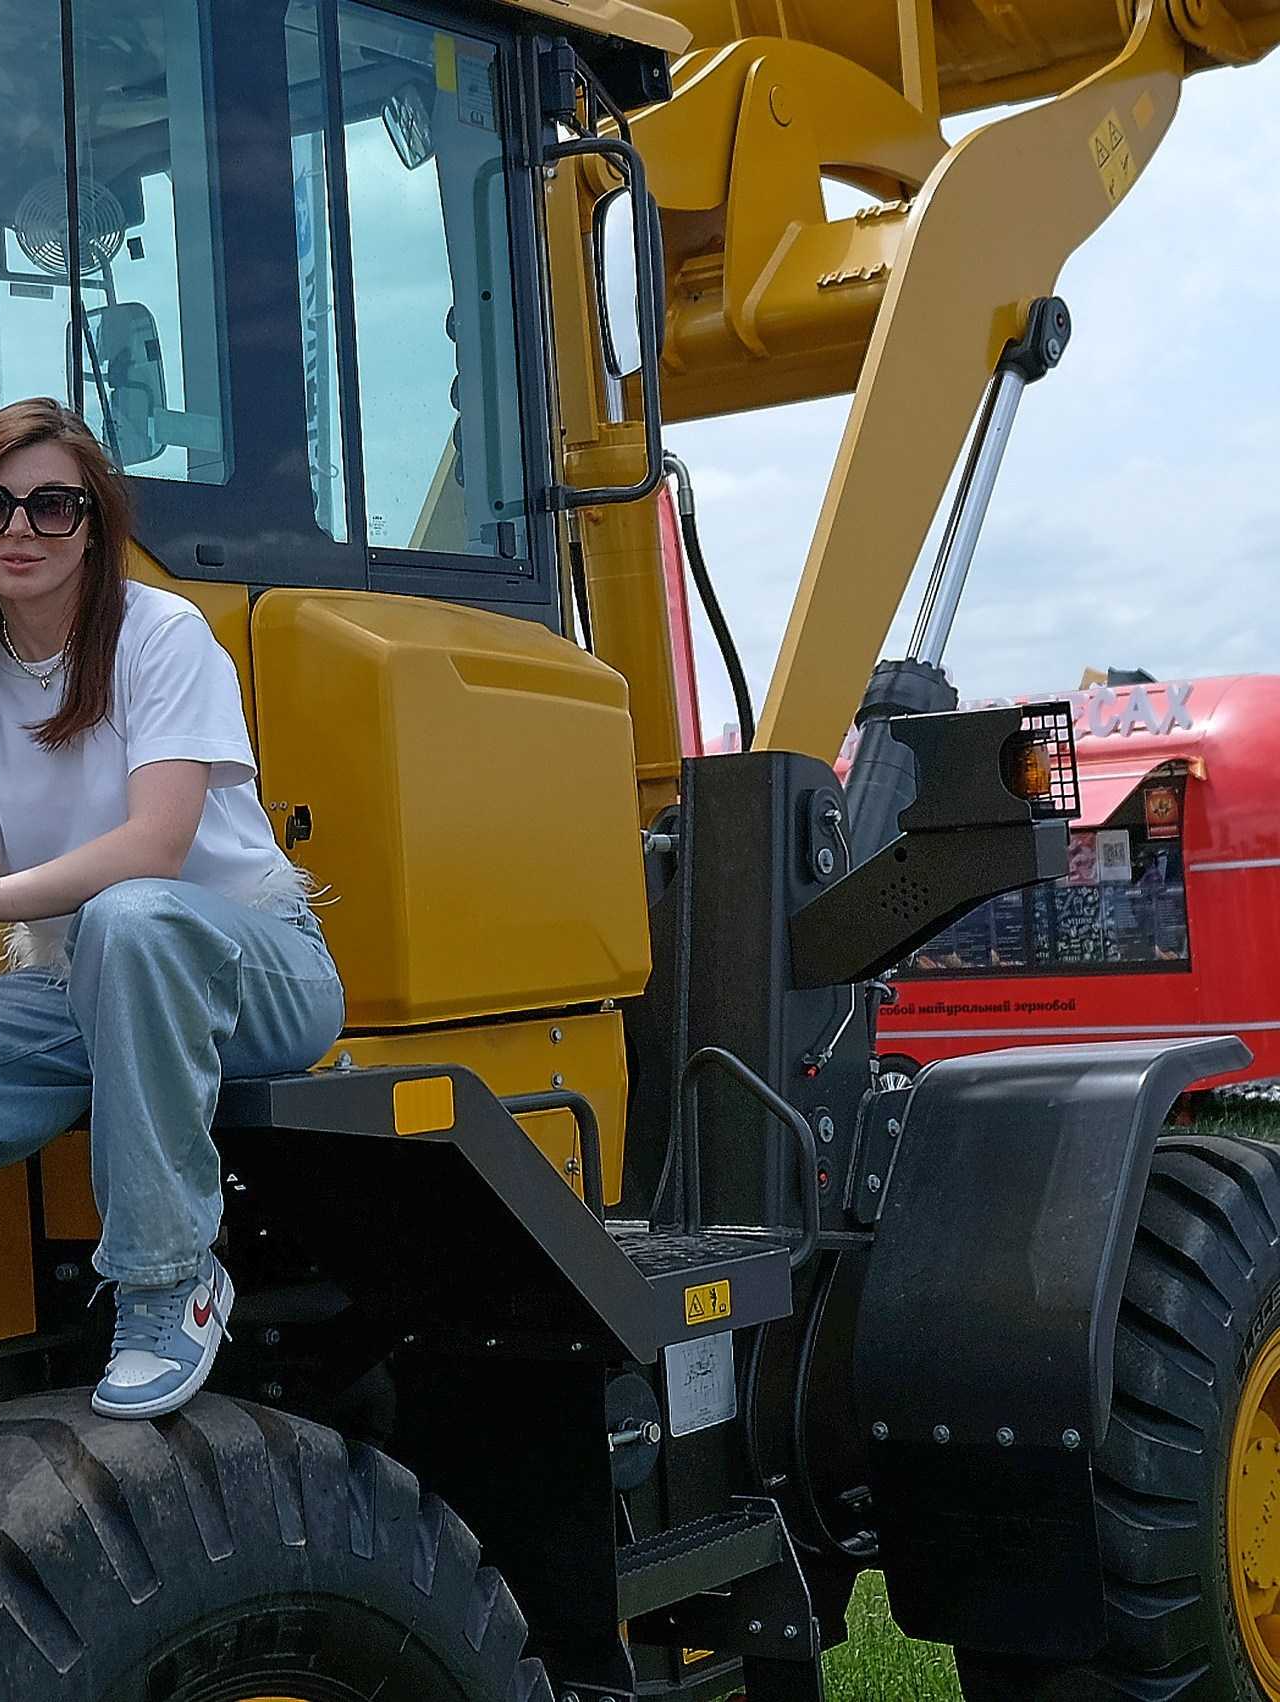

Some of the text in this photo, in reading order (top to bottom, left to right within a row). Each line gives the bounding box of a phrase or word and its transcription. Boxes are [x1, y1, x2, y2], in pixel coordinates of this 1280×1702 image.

[880, 999, 1076, 1016] собой натуральный зерновой
